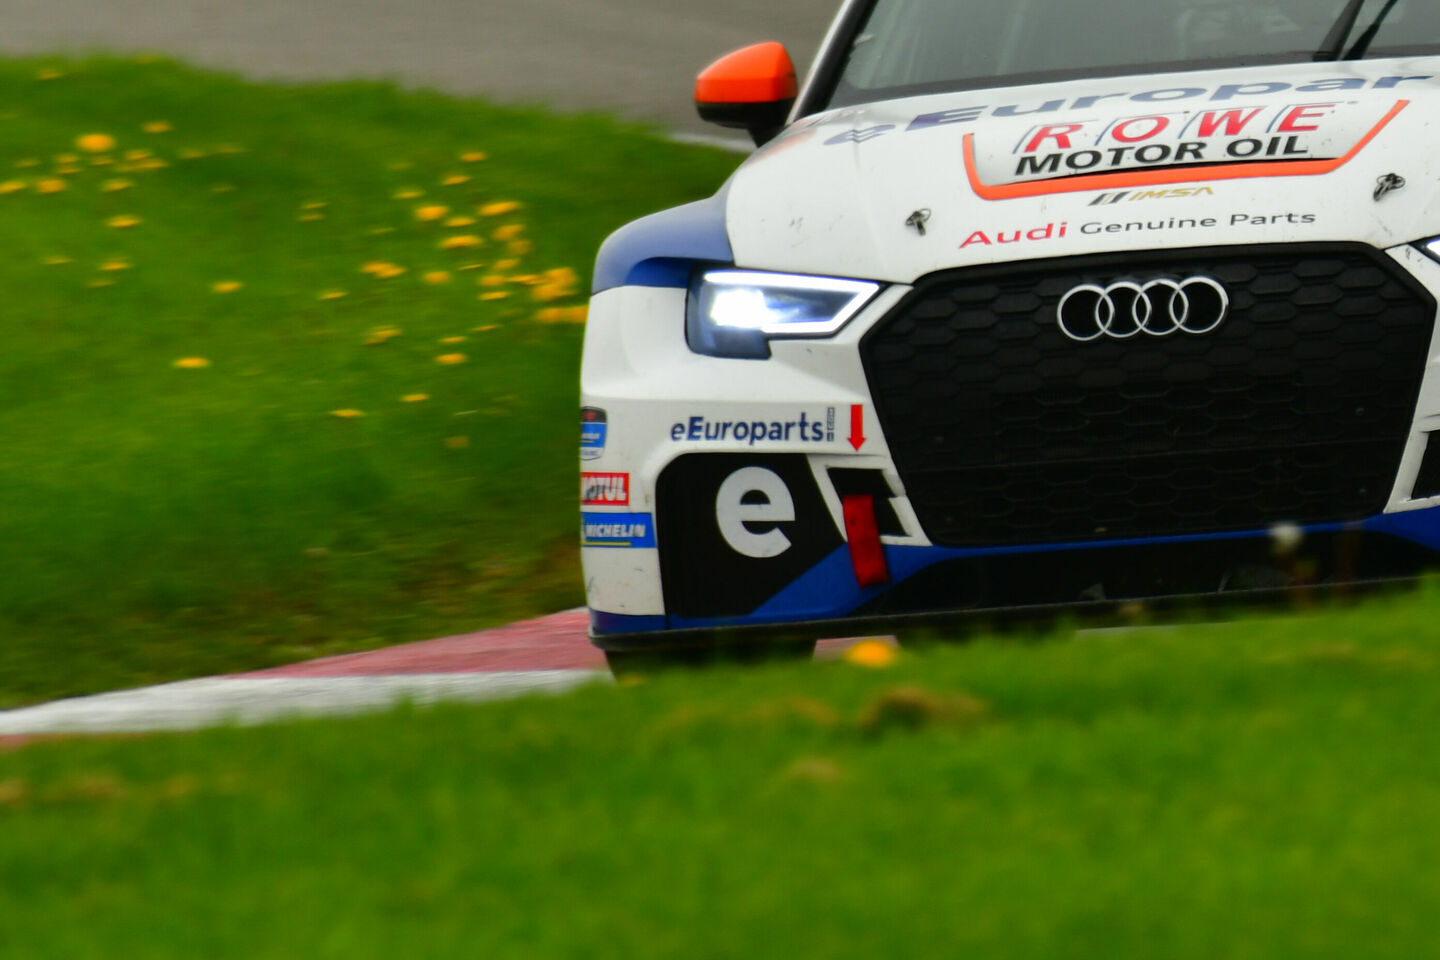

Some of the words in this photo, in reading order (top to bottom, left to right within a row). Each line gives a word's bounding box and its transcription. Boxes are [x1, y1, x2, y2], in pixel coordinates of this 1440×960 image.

[1018, 103, 1339, 154] ROWE
[1014, 142, 1209, 177] MOTOR
[1226, 135, 1309, 158] OIL
[1128, 186, 1214, 201] IMSA
[958, 222, 1068, 249] Audi
[1080, 216, 1217, 236] Genuine
[1229, 211, 1316, 227] Parts
[670, 412, 824, 445] eEuroparts
[715, 465, 796, 559] e
